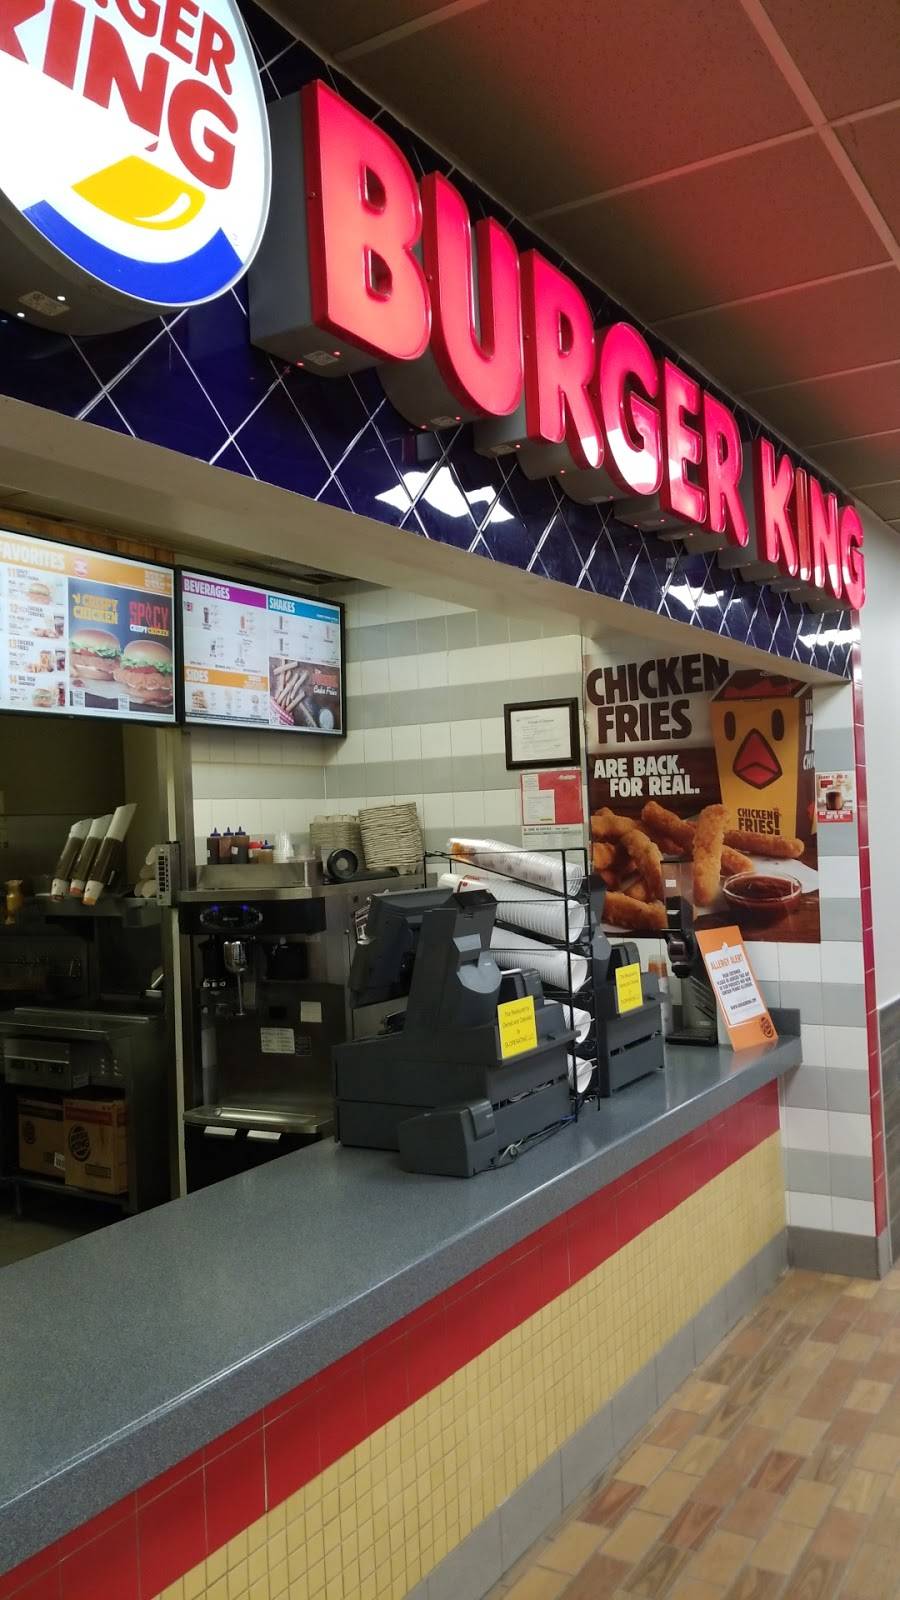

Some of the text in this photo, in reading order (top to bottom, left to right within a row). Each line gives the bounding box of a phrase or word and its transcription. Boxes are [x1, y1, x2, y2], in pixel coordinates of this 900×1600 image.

[95, 0, 236, 96] GER
[303, 79, 866, 609] BURGER KING
[184, 578, 230, 600] BEVERAGES
[73, 606, 118, 624] CHICKEN
[129, 601, 169, 629] SPICY
[269, 597, 296, 613] SHAKES
[586, 652, 730, 706] CHICKEN
[597, 699, 692, 744] FRIES
[594, 755, 685, 779] ARE BACK.
[609, 774, 700, 798] FOR REAL.
[737, 807, 774, 820] CHICKEN
